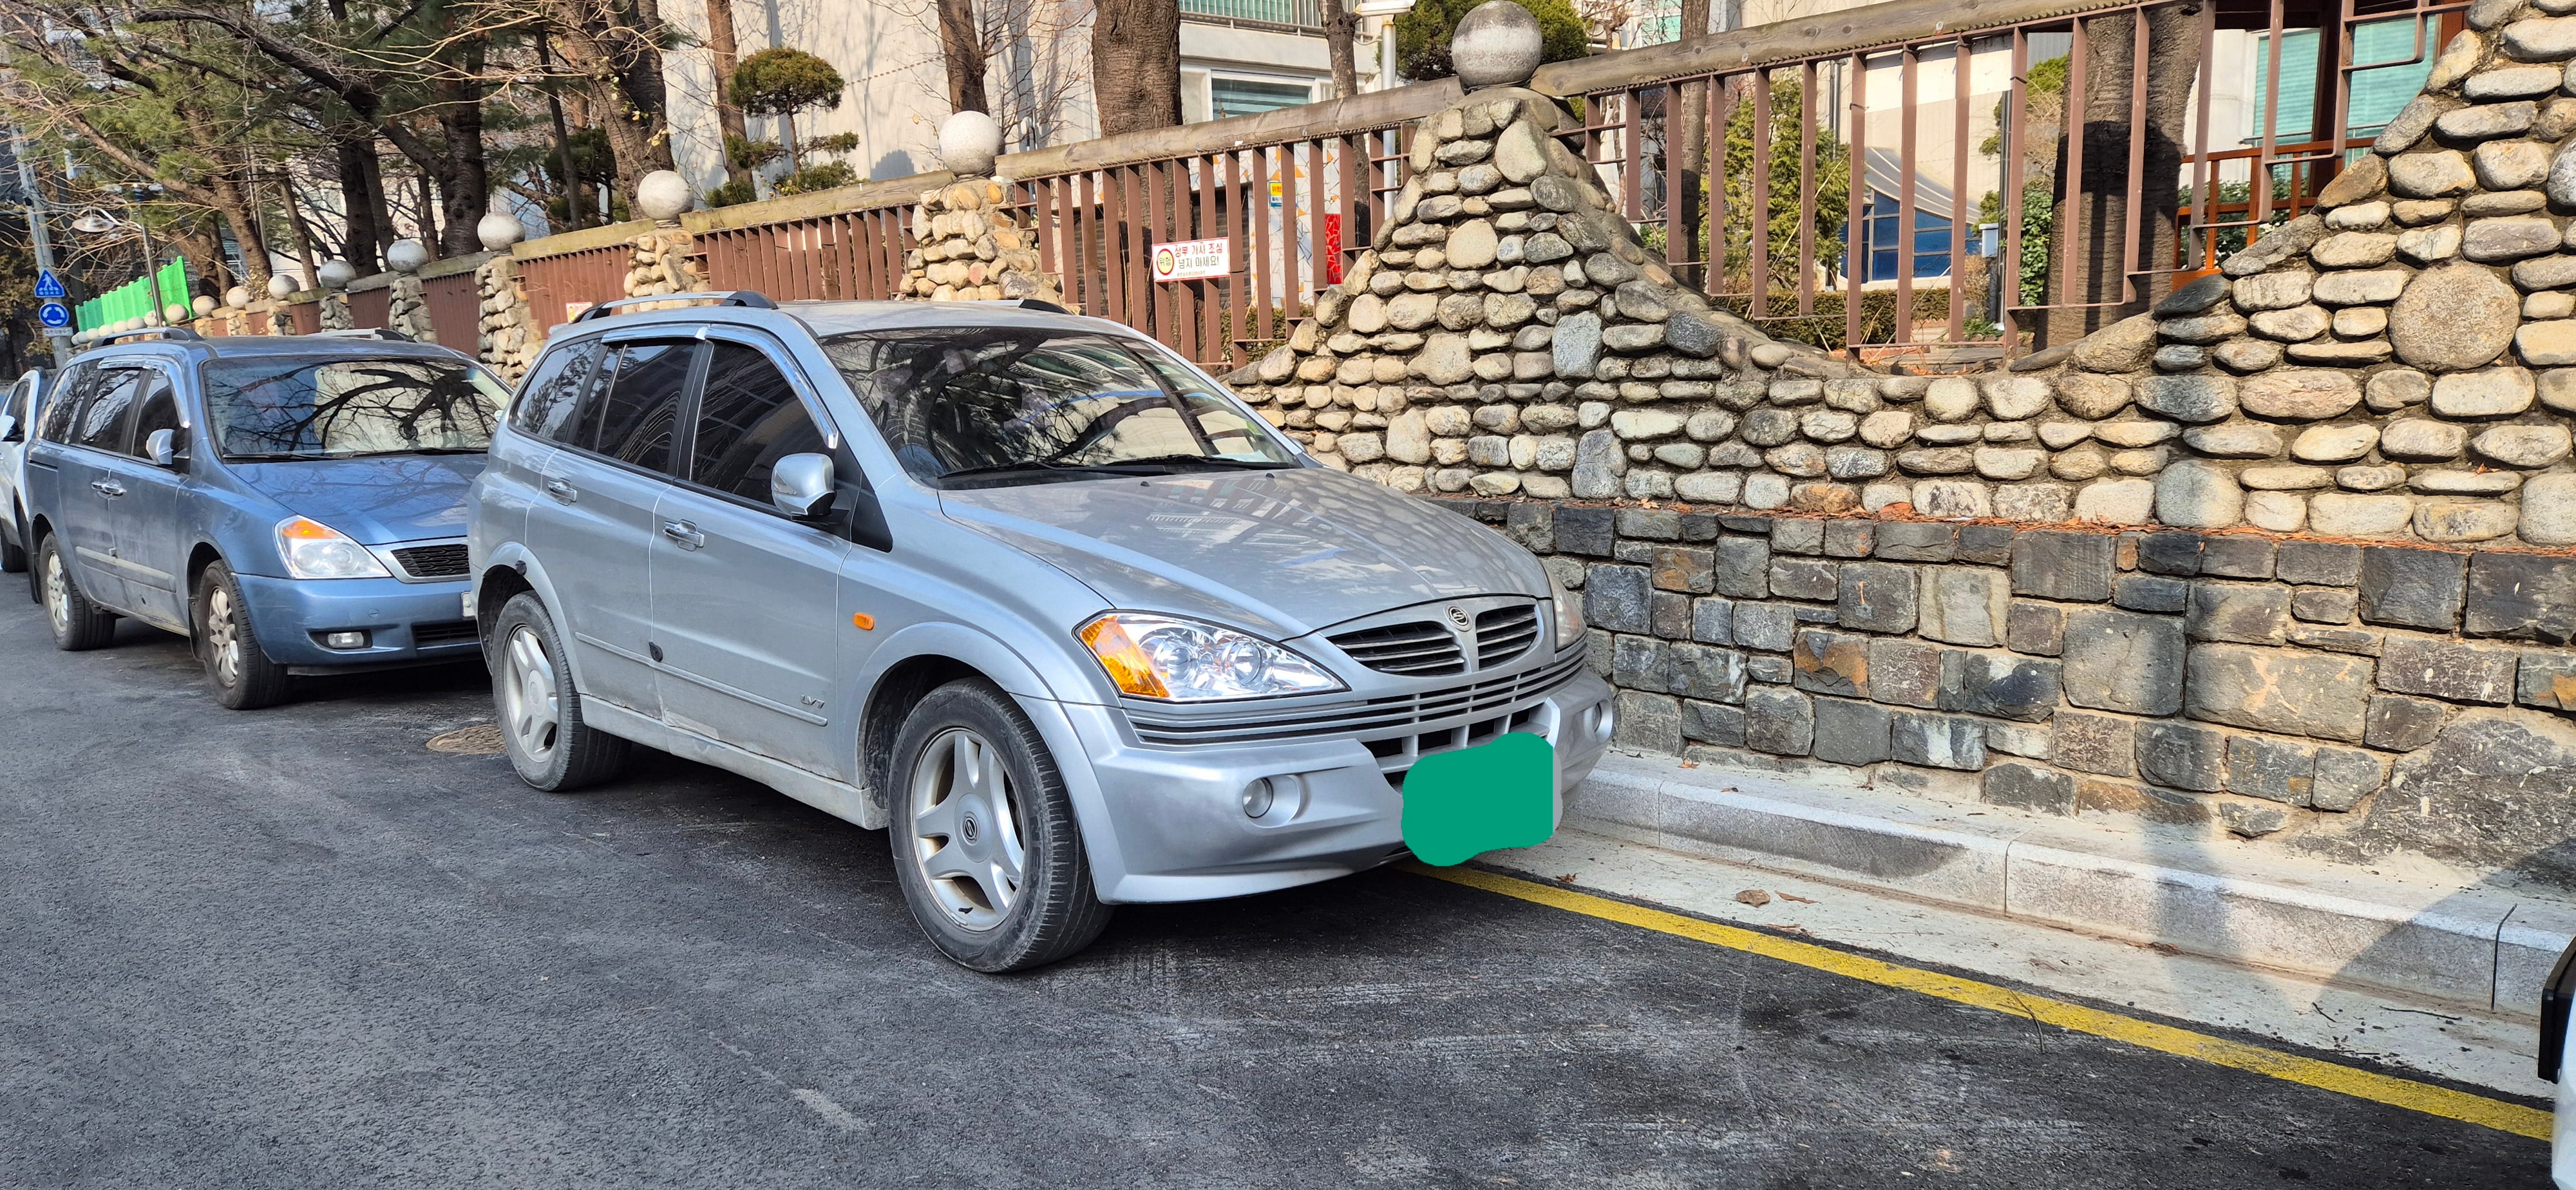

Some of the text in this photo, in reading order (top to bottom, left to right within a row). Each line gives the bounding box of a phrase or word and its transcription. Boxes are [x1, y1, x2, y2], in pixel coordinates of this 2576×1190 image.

[1209, 242, 1222, 254] 조심
[1159, 257, 1171, 266] 위험
[1179, 256, 1219, 269] 넘지 마세요!
